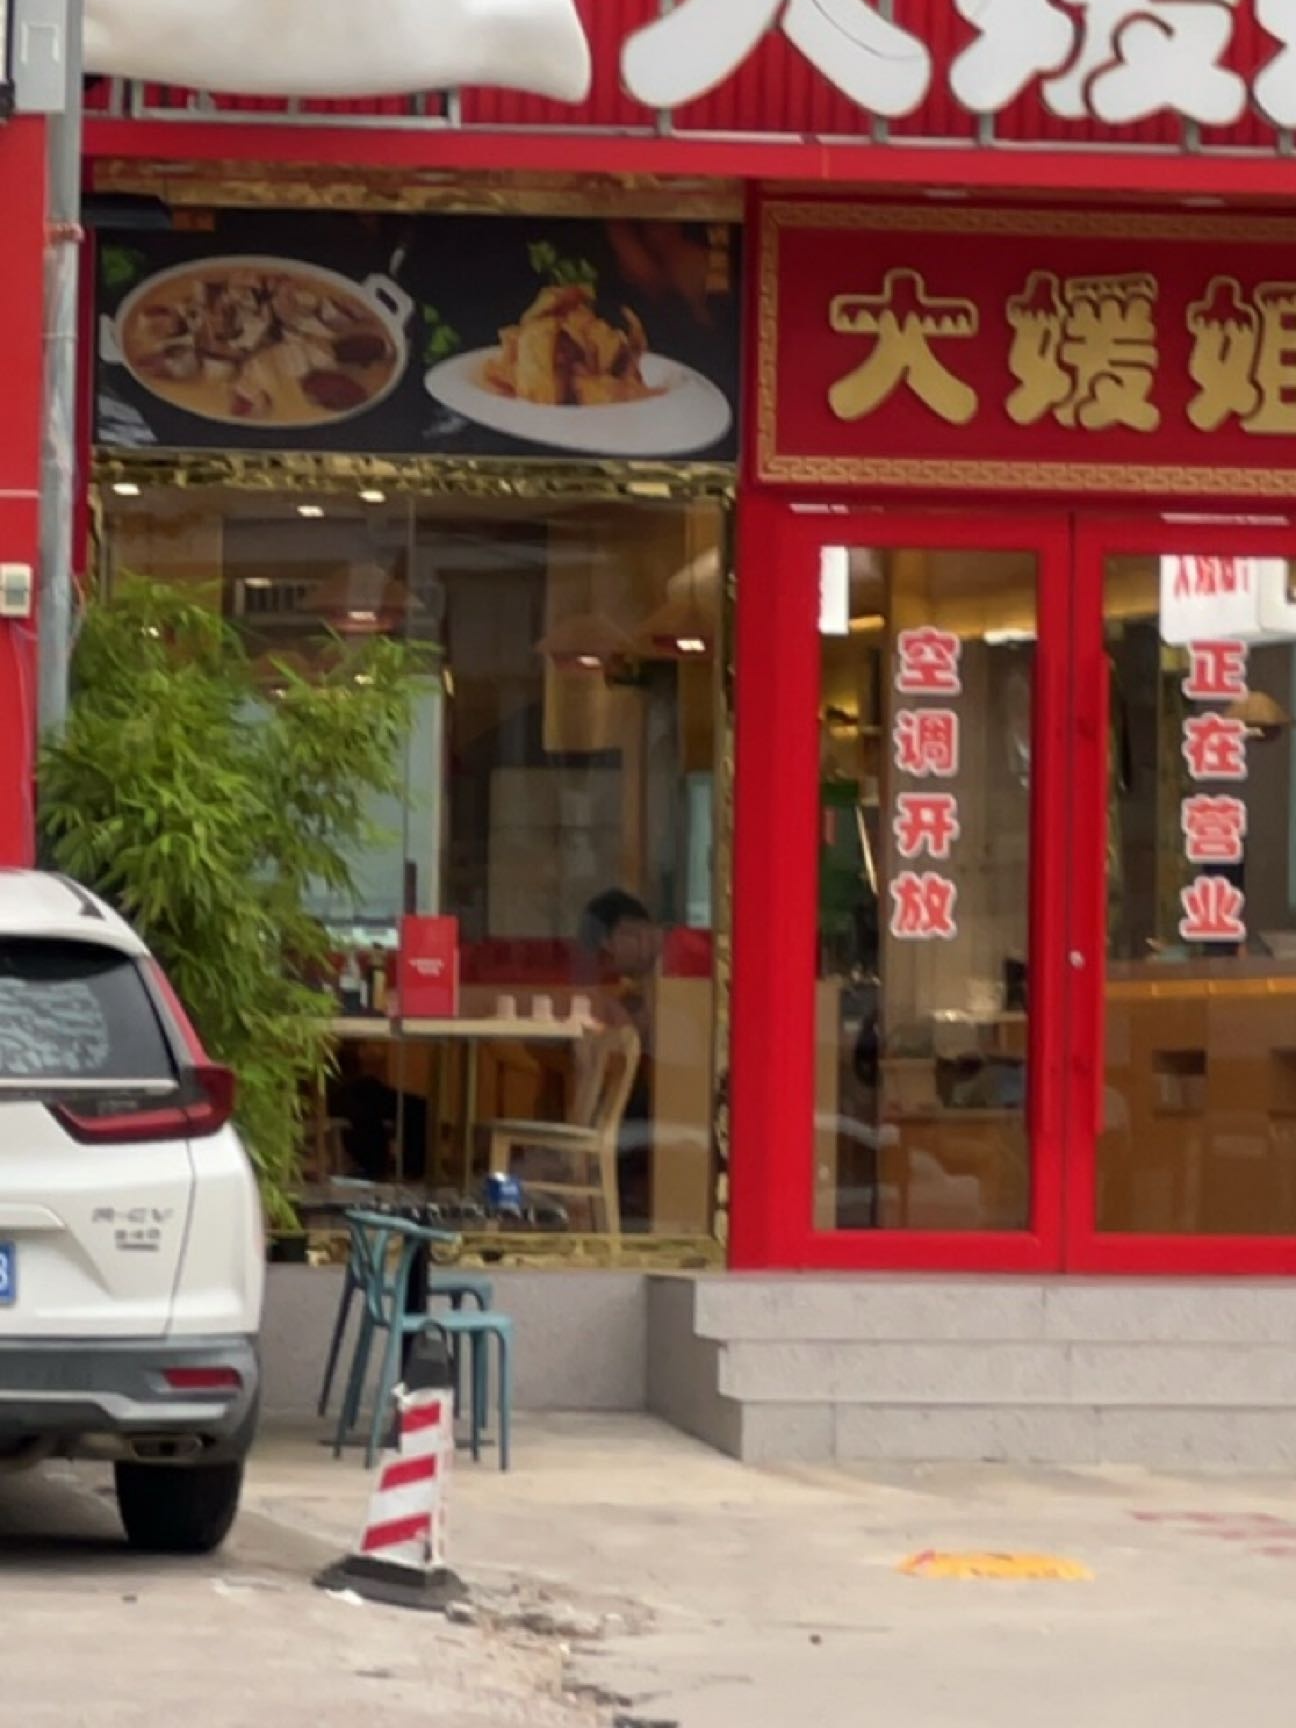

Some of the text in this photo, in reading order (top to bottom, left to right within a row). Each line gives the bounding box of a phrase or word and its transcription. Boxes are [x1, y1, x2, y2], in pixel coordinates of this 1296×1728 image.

[893, 627, 961, 940] 空调开放
[1180, 639, 1248, 943] 正在营业
